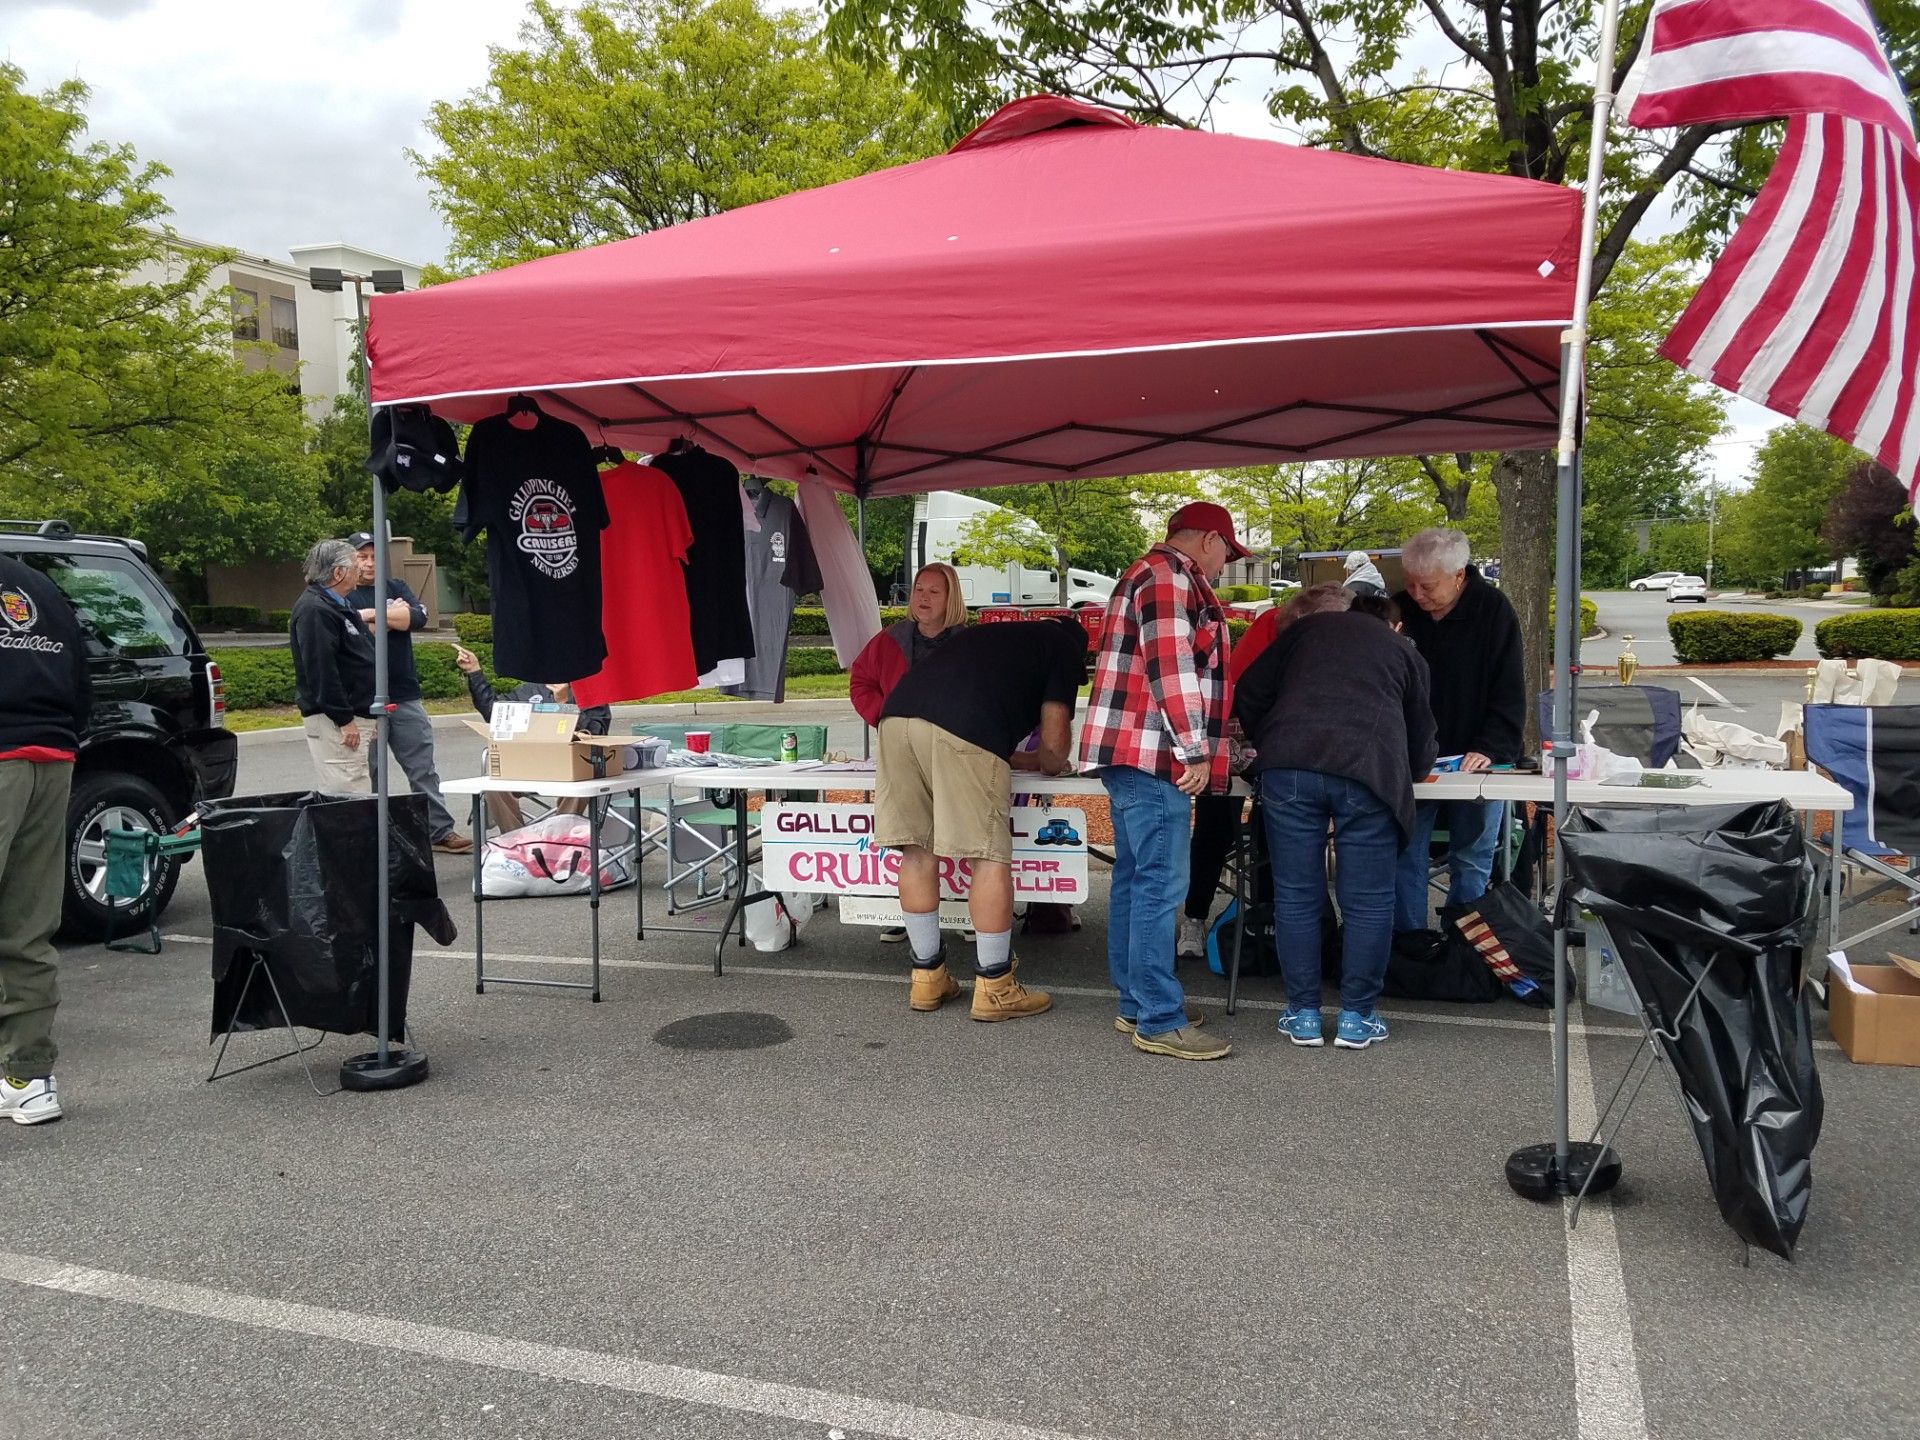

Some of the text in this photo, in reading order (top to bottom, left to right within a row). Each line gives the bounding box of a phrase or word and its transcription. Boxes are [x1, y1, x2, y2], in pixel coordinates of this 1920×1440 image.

[509, 478, 556, 521] GALLOPING
[530, 554, 580, 579] NEW JERSEY
[776, 812, 875, 834] GALLO
[788, 841, 972, 895] CRUISRS
[1011, 876, 1078, 893] LUB
